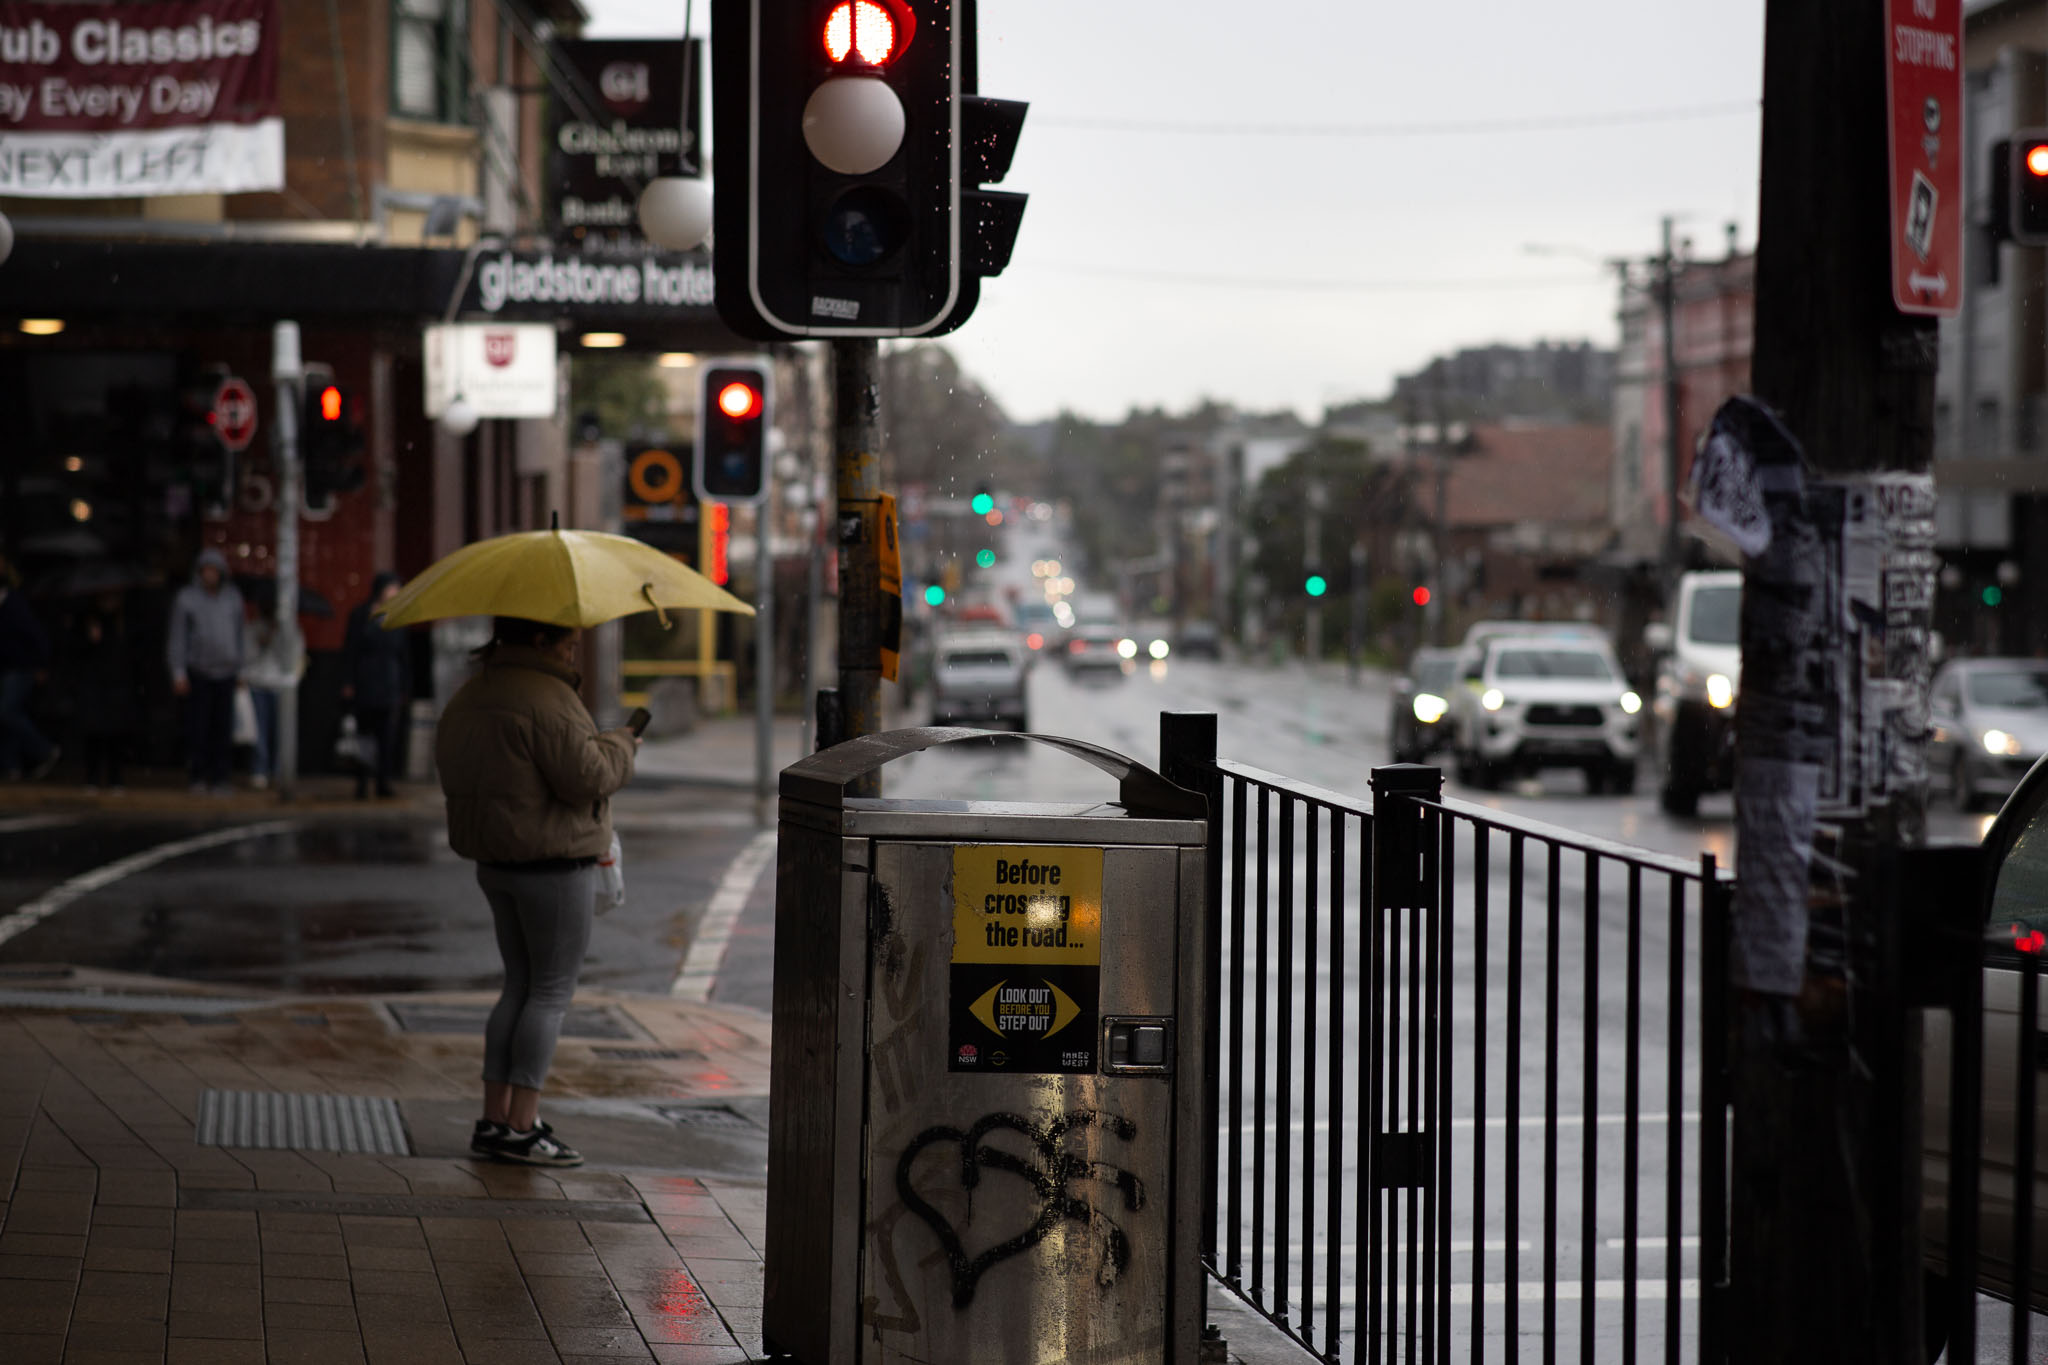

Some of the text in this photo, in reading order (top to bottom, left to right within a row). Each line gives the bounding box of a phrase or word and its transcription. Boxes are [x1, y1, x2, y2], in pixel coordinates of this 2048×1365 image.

[0, 15, 260, 64] ub Classics
[1896, 26, 1955, 70] STOPPING
[41, 77, 143, 123] Every
[151, 75, 220, 118] Day
[113, 142, 208, 183] LEFT
[479, 251, 641, 312] gladstone
[996, 859, 1061, 885] Before
[986, 921, 1018, 947] the
[1000, 988, 1050, 1004] LOOK OUT
[1000, 1004, 1050, 1015] BEFORE YOU
[1000, 1015, 1050, 1031] STEP OUT
[959, 1055, 978, 1064] NSW
[1062, 1059, 1089, 1067] WEST
